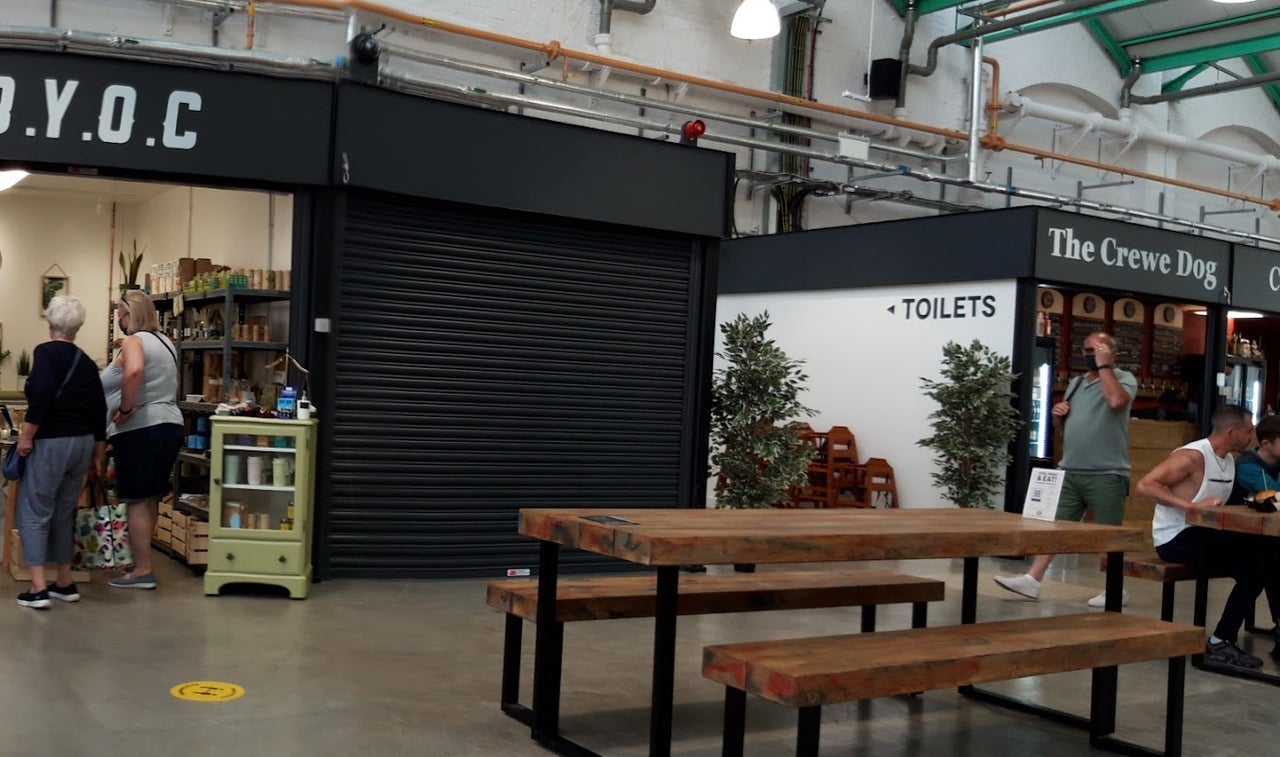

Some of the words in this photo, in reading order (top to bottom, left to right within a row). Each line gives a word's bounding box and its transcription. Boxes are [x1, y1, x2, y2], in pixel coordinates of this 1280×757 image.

[1048, 227, 1095, 262] The
[1100, 237, 1171, 275] Crewe
[1176, 249, 1218, 291] Dog
[901, 295, 996, 320] TOILETS
